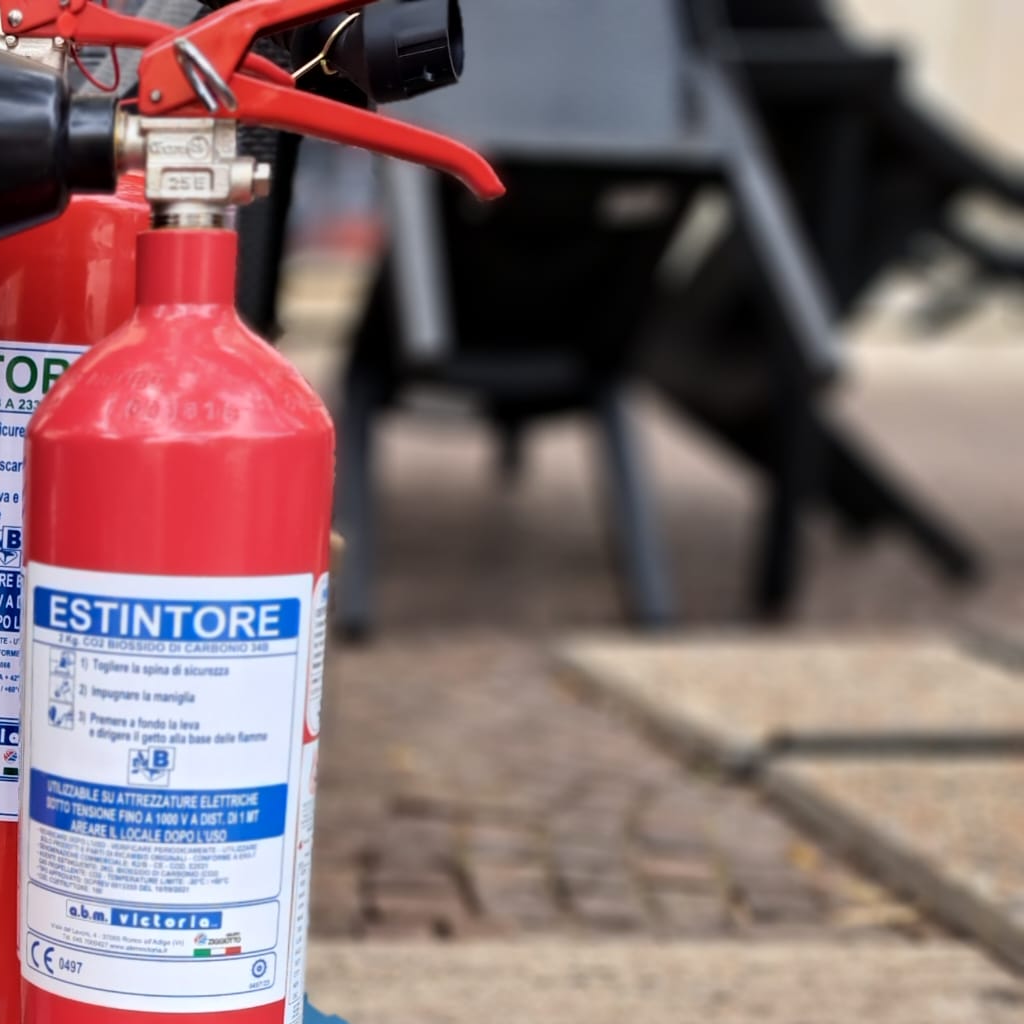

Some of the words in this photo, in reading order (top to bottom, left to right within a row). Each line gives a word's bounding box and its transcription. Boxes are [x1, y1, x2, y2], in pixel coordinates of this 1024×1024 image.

[4, 398, 15, 410] A
[0, 458, 22, 473] scar
[6, 529, 21, 549] B
[6, 596, 14, 609] A
[48, 594, 281, 638] ESTINTORE
[82, 637, 104, 648] CO2
[108, 638, 166, 652] BIOSSIDO
[184, 642, 248, 653] CARBONIO
[80, 658, 88, 670] 1)
[92, 658, 129, 676] Togliere
[132, 662, 140, 674] la
[142, 664, 170, 678] spina
[173, 664, 182, 676] di
[184, 664, 230, 676] sicurezza
[79, 684, 87, 696] 2)
[92, 684, 140, 704] Impugnare
[142, 690, 152, 702] la
[154, 690, 196, 706] maniglia
[90, 712, 126, 728] Premere
[138, 716, 166, 730] fondo
[180, 720, 200, 730] leva
[97, 728, 131, 743] dirigere
[142, 732, 166, 746] getto
[169, 732, 186, 744] alla
[189, 732, 212, 744] base
[214, 732, 236, 744] delle
[238, 730, 268, 743] fiamme
[152, 750, 169, 767] B
[47, 781, 100, 802] UTILIZZABILE
[101, 789, 116, 804] SU
[117, 792, 198, 808] ATTREZZATURE
[200, 792, 259, 808] ELETTRICHE
[46, 796, 71, 814] SOTTO
[72, 802, 116, 819] TENSIONE
[118, 809, 142, 824] FINO
[156, 812, 178, 825] 1000
[200, 812, 226, 825] DIST.
[246, 809, 260, 824] MT
[70, 820, 108, 837] AREARE
[120, 828, 162, 844] LOCALE
[164, 830, 194, 844] DOPO
[196, 829, 228, 843] L'USO
[69, 904, 108, 922] a.b.m.
[119, 912, 210, 929] victoria
[58, 957, 83, 974] 0497
